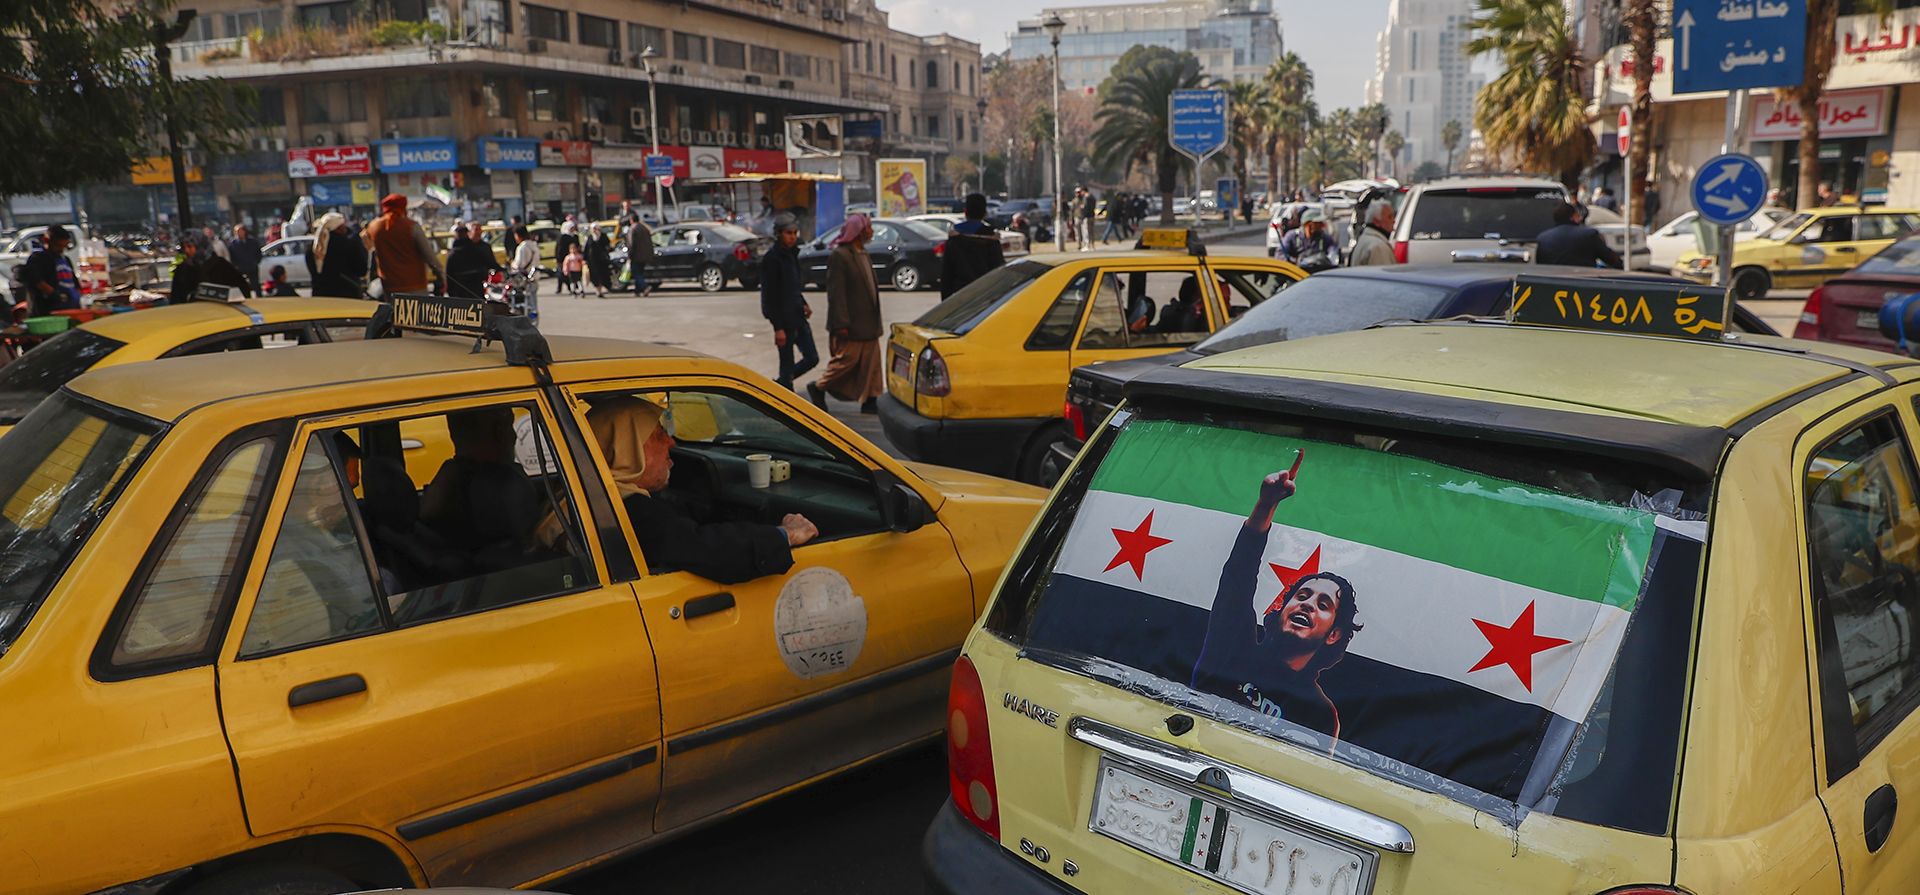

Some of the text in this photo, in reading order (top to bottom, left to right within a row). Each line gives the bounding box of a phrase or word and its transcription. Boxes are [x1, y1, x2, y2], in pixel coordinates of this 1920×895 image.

[1717, 0, 1789, 21] محافظة
[1720, 40, 1786, 73] دمشق
[1843, 24, 1920, 62] الخيا
[1764, 102, 1828, 127] اليام
[402, 149, 452, 164] MABCO
[393, 299, 418, 326] TAXI
[448, 303, 483, 331] تكسي
[1554, 289, 1653, 325] ٢١٤٥٨
[1674, 295, 1723, 334] رة
[1003, 692, 1060, 729] HARE
